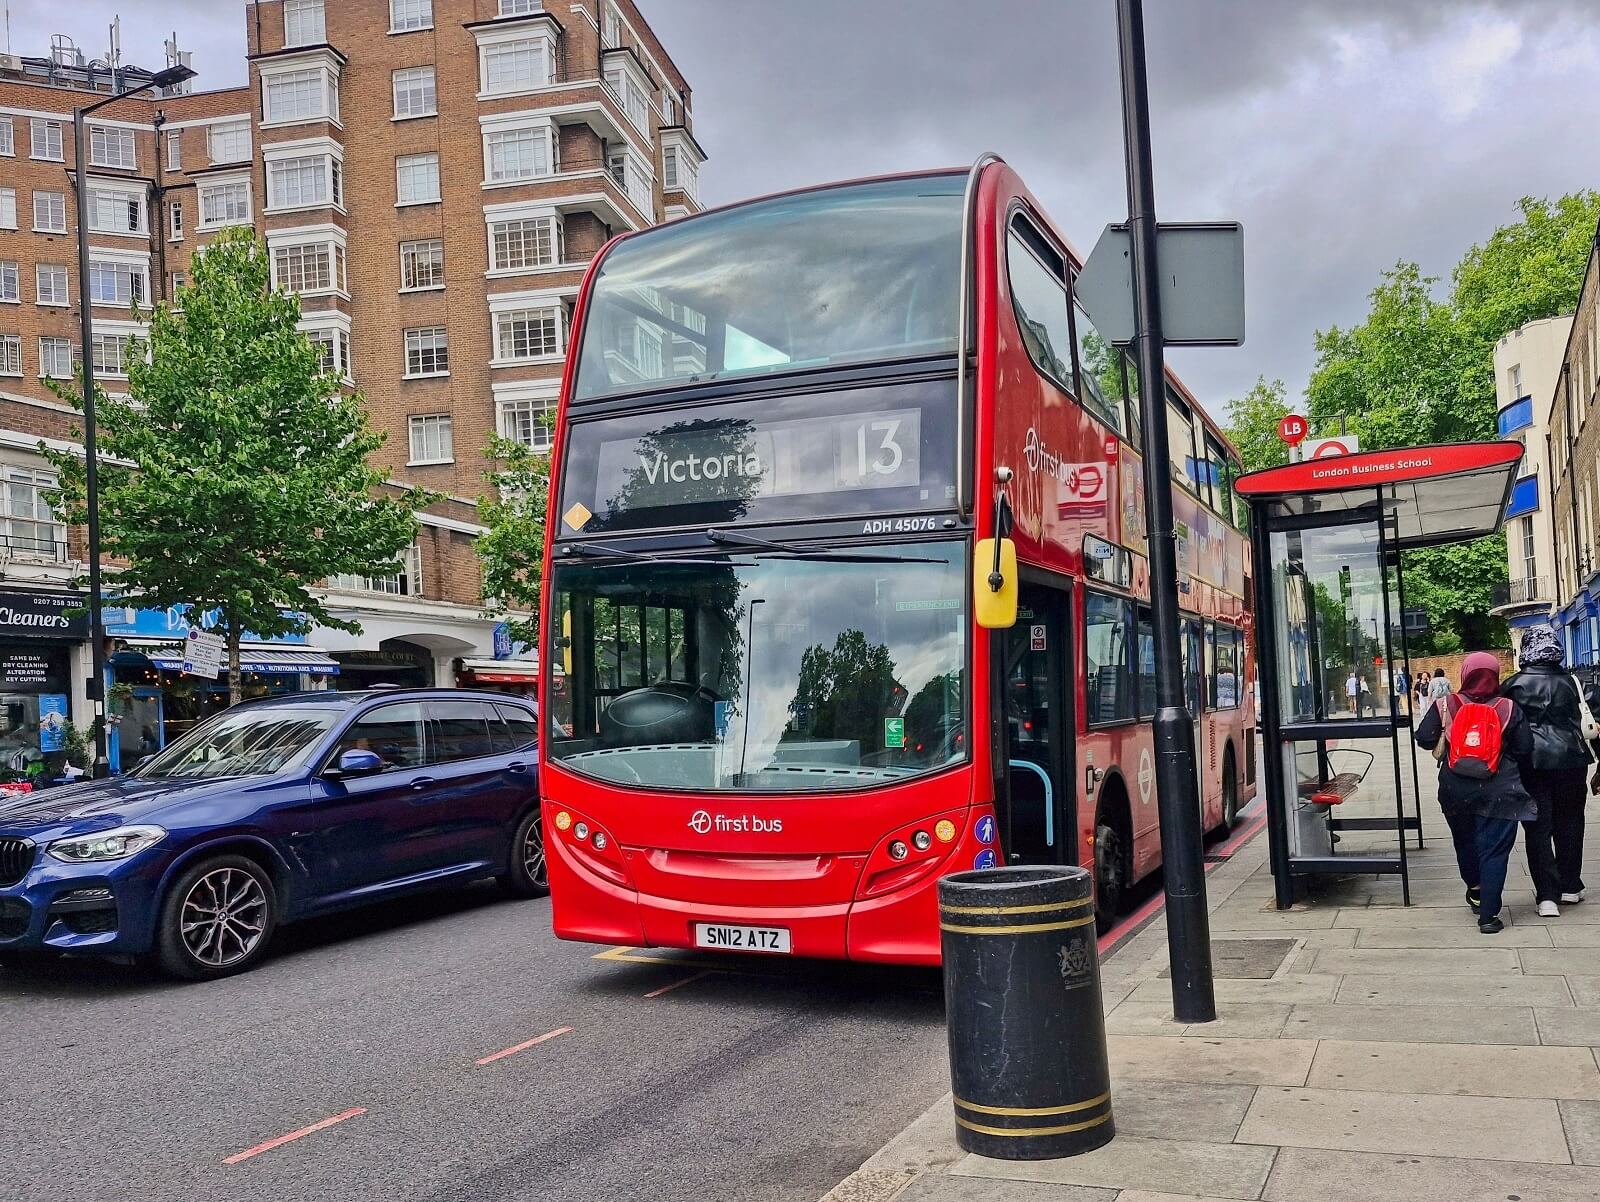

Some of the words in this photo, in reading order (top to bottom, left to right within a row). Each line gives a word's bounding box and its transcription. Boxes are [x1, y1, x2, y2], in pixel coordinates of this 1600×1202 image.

[1284, 421, 1302, 436] LB
[856, 419, 904, 477] 13
[639, 448, 761, 486] Victoria
[1040, 441, 1059, 479] first
[1312, 467, 1350, 479] London
[1352, 461, 1395, 474] Business
[1397, 457, 1432, 470] School
[862, 520, 892, 534] ADH
[895, 518, 936, 532] 45076
[0, 607, 70, 628] Cleaners
[714, 814, 749, 832] first
[752, 814, 782, 832] bus
[706, 927, 743, 947] SN12
[747, 929, 780, 949] ATZ
